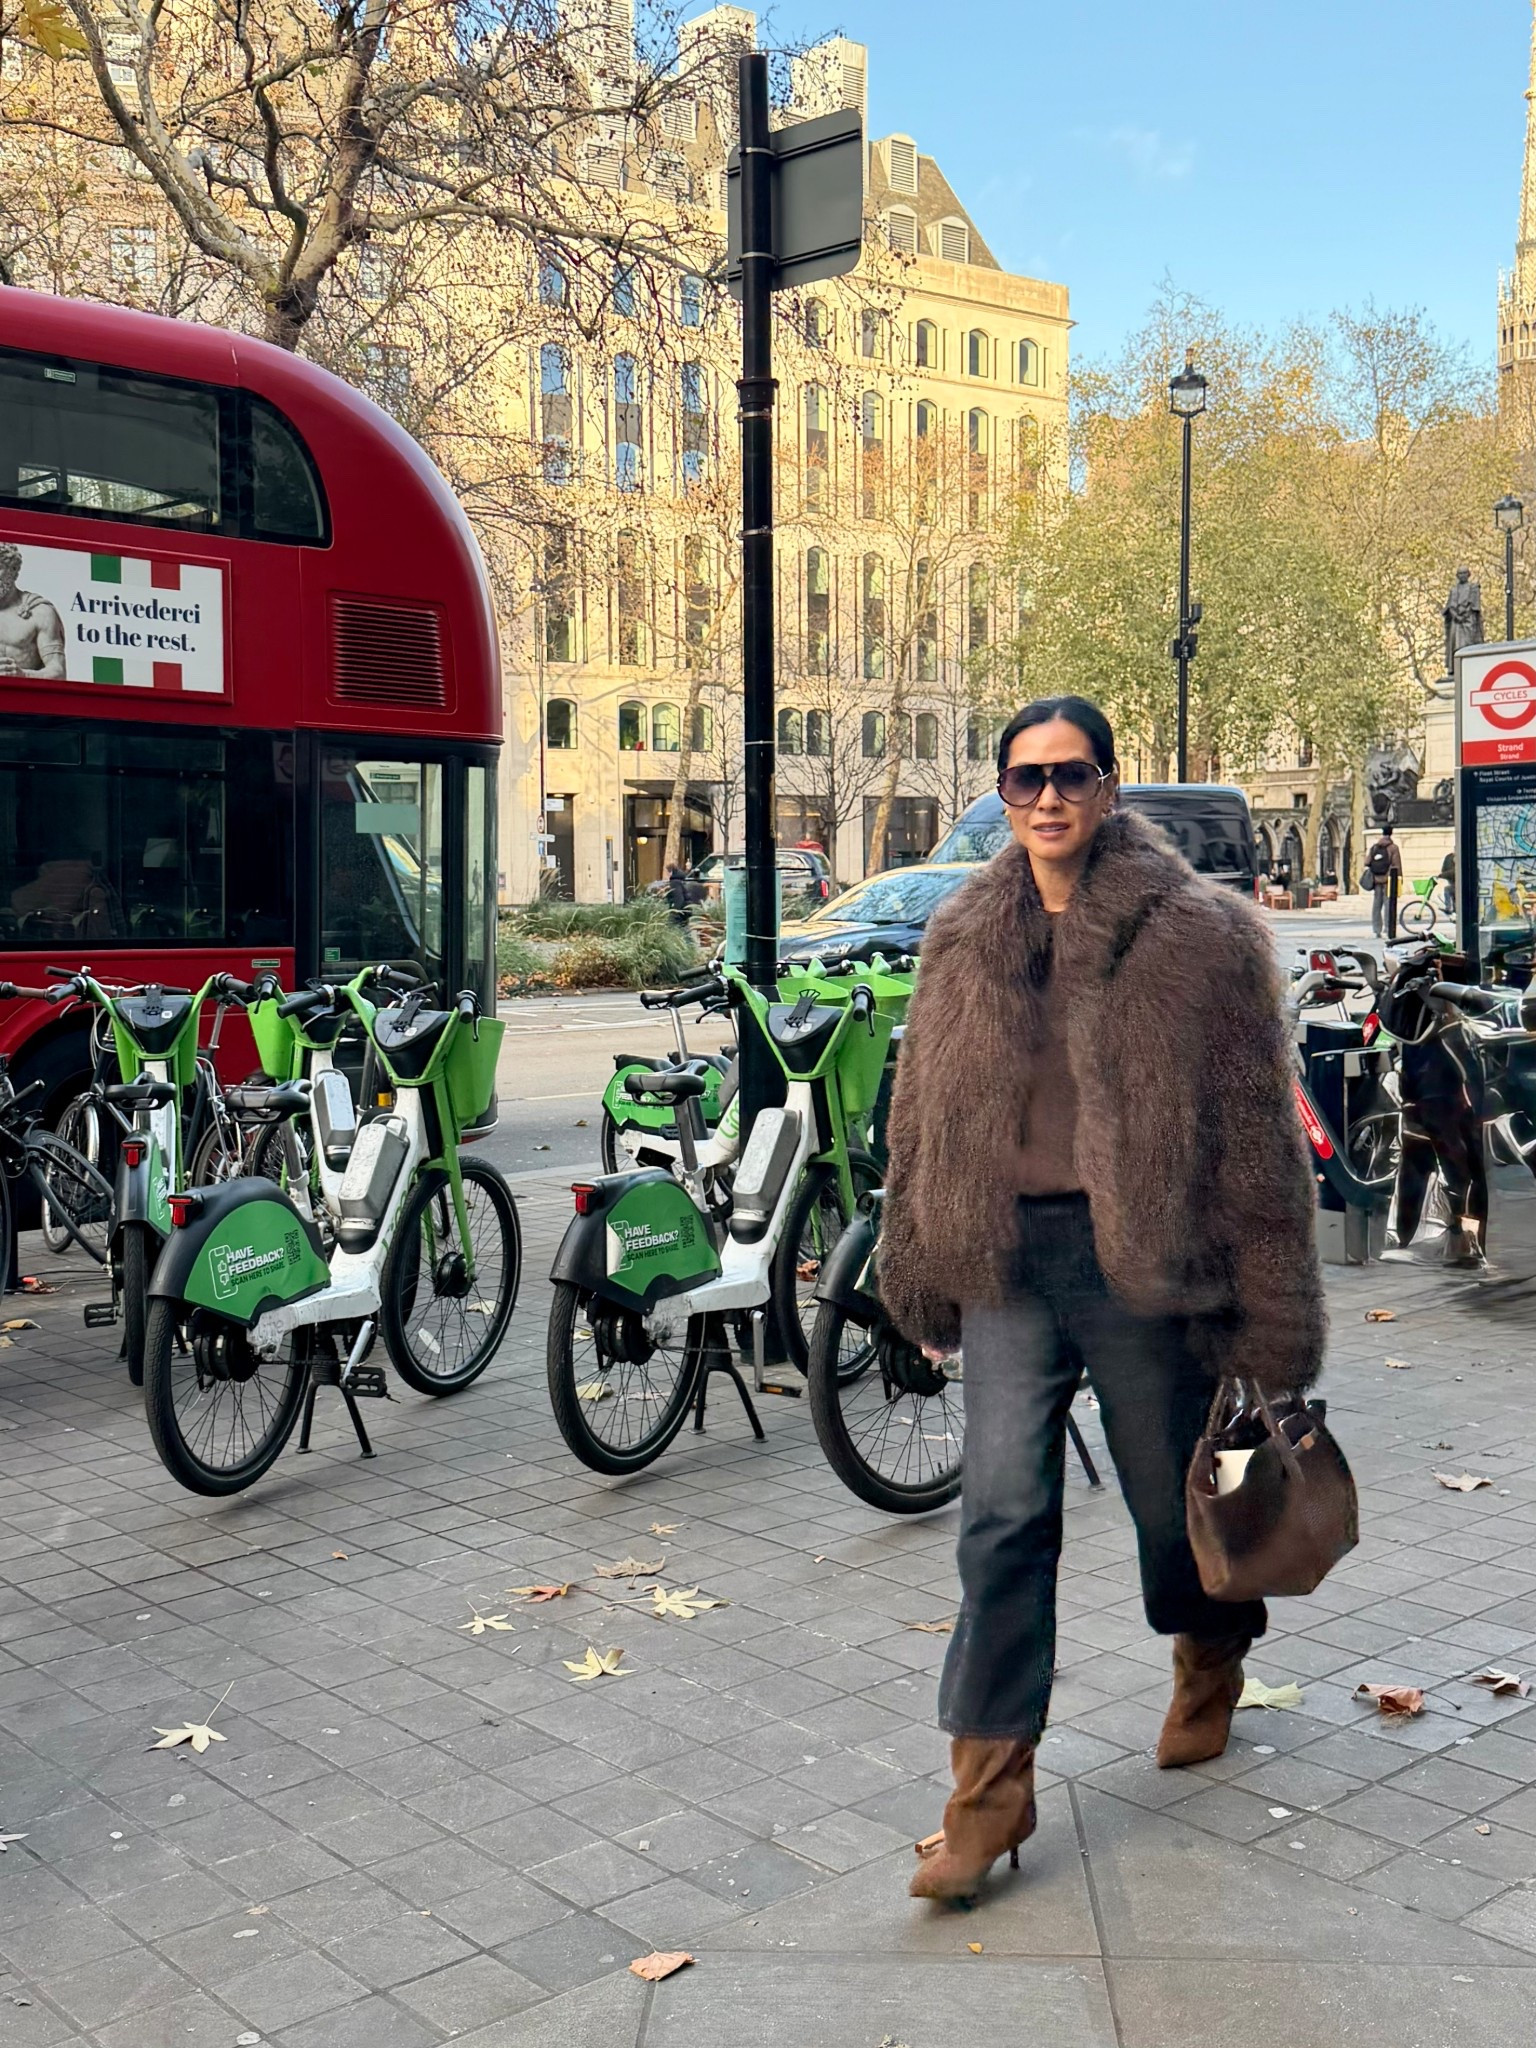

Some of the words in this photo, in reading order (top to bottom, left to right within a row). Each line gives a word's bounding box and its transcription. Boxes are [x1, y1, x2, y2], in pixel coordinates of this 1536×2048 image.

[70, 591, 201, 624] Arrivederci
[76, 623, 100, 643] to
[106, 624, 142, 647] the
[147, 633, 196, 652] rest.
[1493, 690, 1528, 701] CYCLES
[1497, 743, 1524, 752] Strand
[624, 1224, 652, 1239] HAVE
[625, 1230, 679, 1251] FEEDBACK?
[226, 1245, 255, 1263] HAVE
[228, 1248, 284, 1276] FEEDBACK?
[627, 1251, 644, 1261] SCAN
[231, 1275, 249, 1286] SCAN
